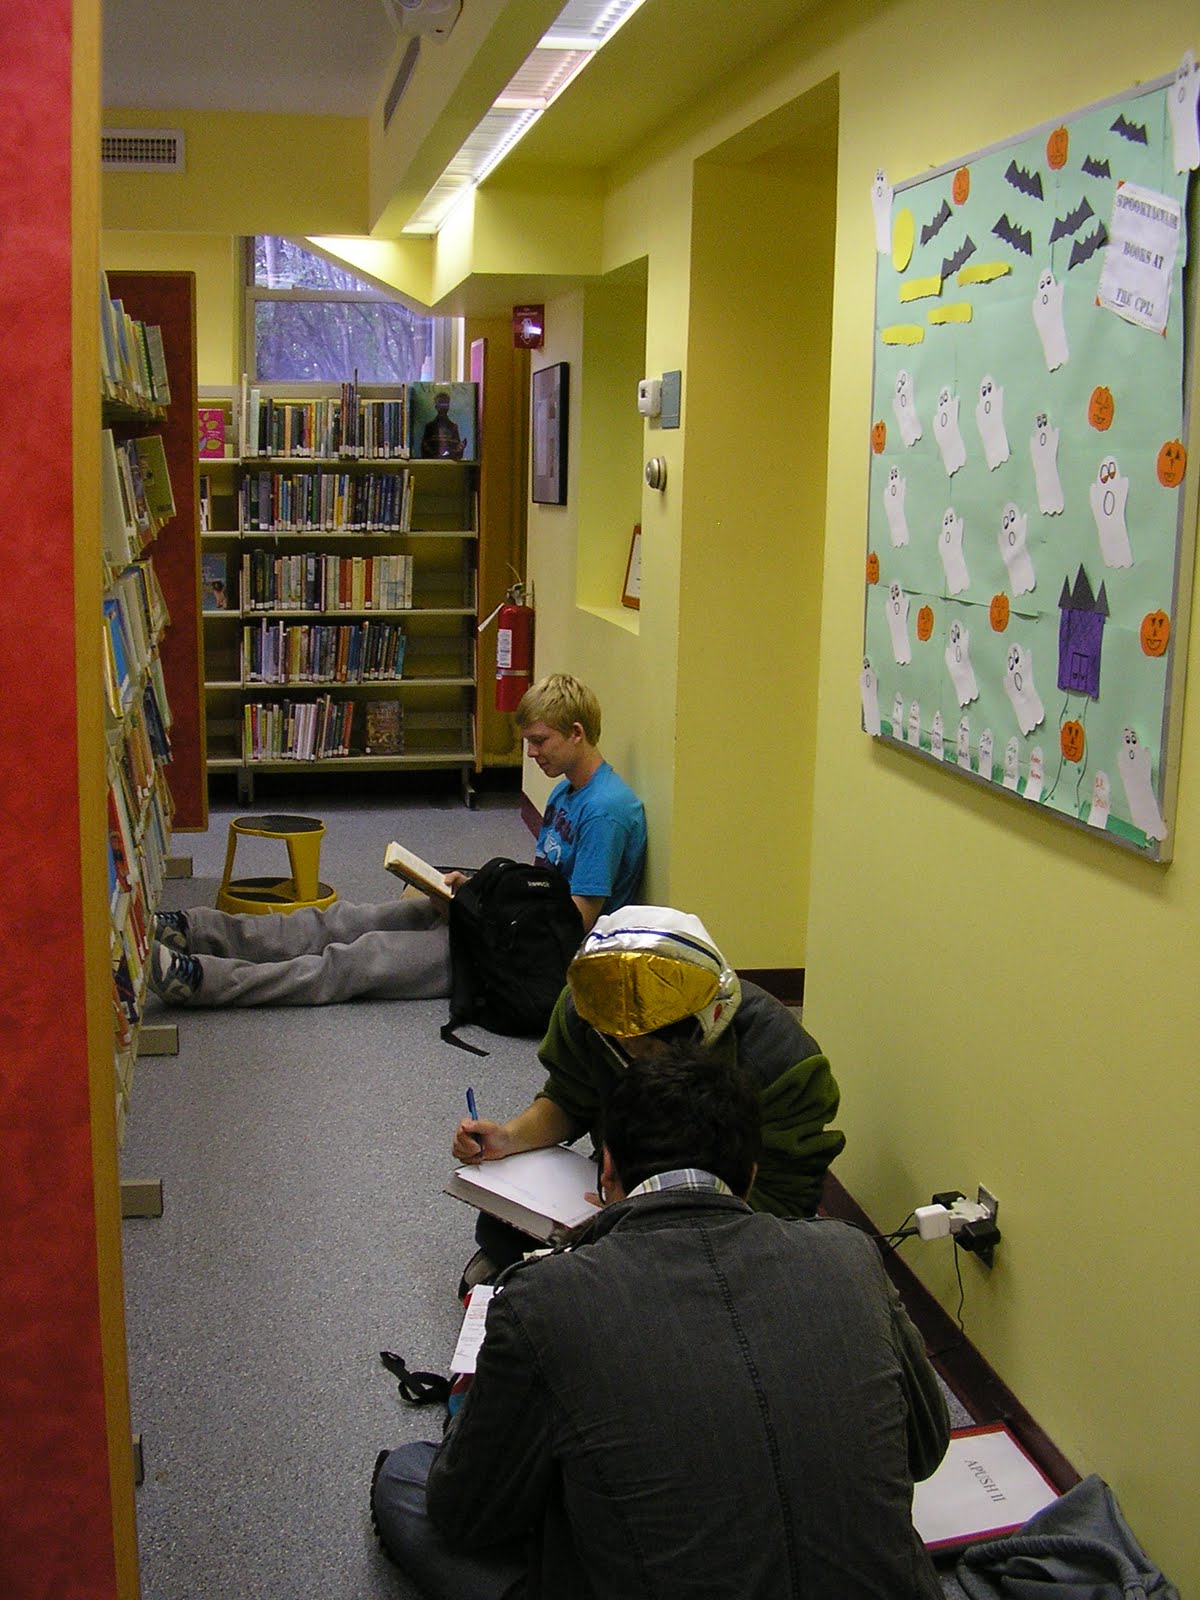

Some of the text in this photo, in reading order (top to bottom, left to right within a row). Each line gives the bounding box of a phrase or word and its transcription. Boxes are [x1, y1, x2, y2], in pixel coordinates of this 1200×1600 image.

[1123, 241, 1165, 270] BOOKS AT
[1115, 288, 1132, 307] THE
[964, 1460, 999, 1493] APUSH
